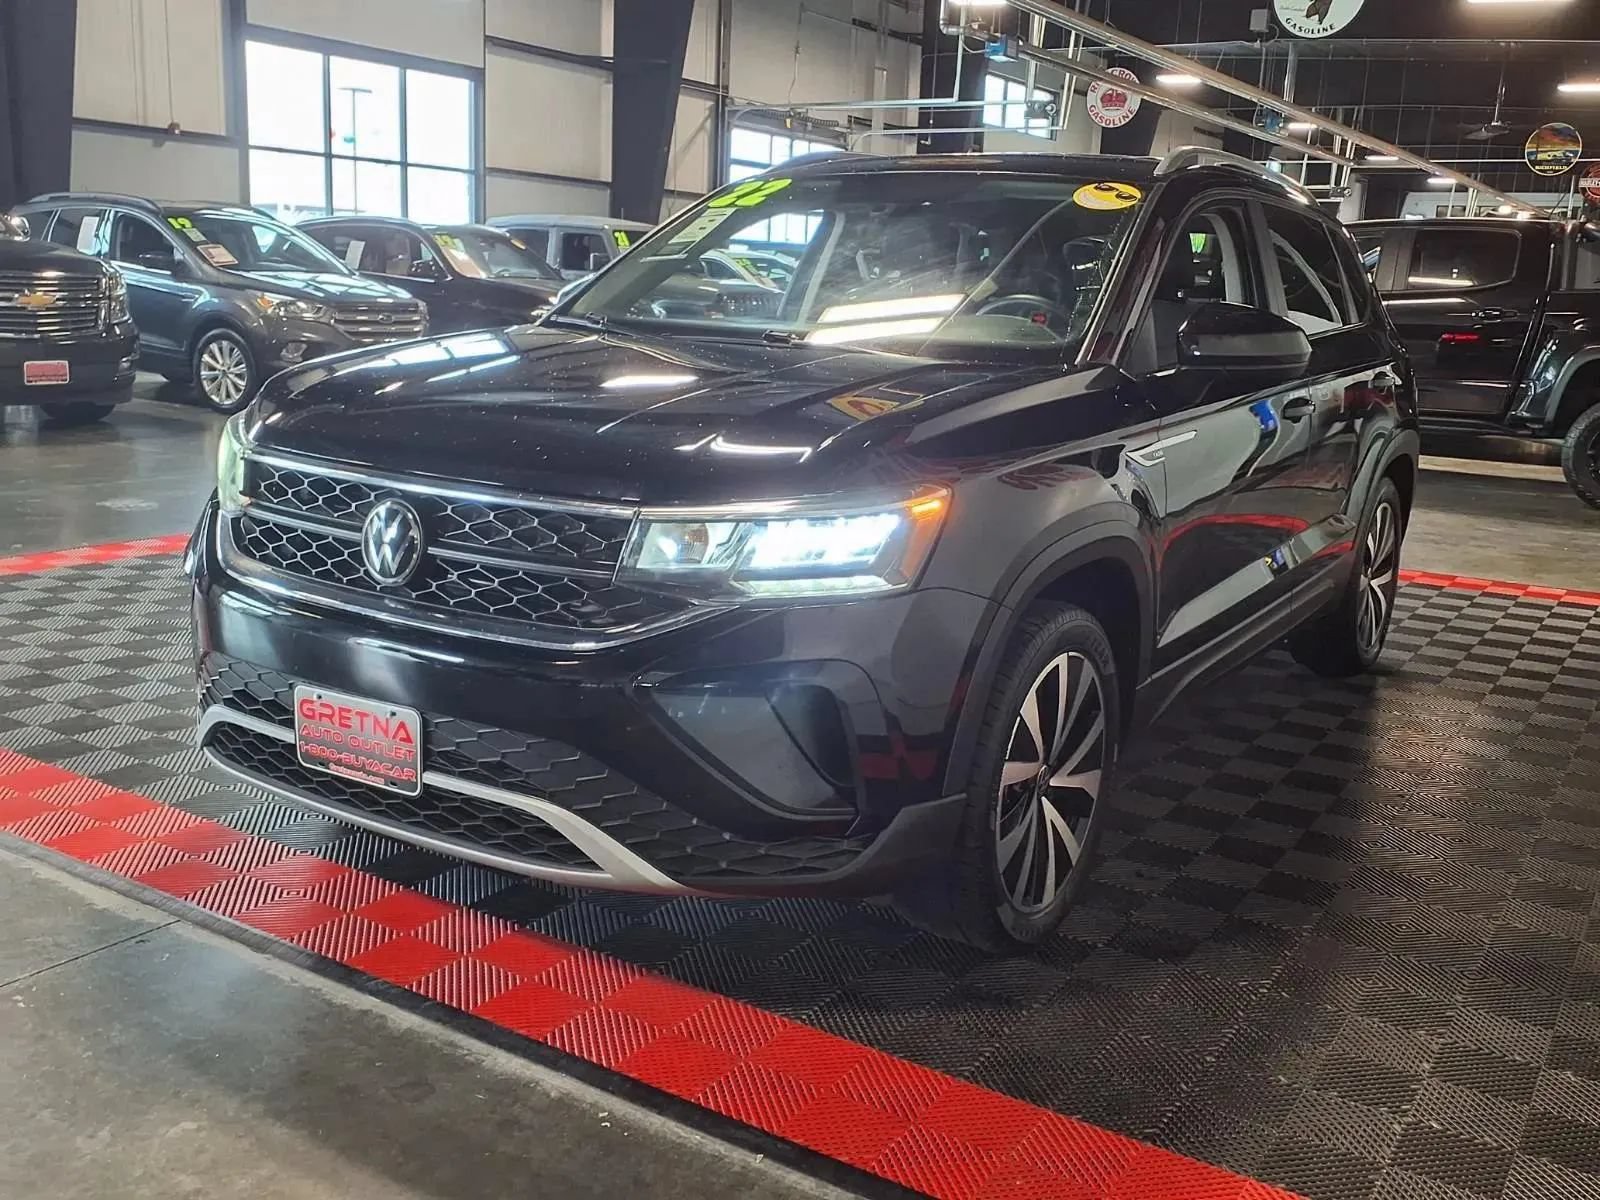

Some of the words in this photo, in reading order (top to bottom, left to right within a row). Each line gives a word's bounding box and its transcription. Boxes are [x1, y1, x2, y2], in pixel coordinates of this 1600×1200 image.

[1285, 17, 1336, 35] GASOLINE
[1089, 104, 1136, 126] GASOLINE
[707, 178, 793, 207] 22
[167, 217, 192, 229] 19
[299, 698, 414, 745] GRETNA
[300, 723, 344, 745] AUTO
[347, 734, 416, 762] OUTLET
[300, 741, 417, 781] 1-800-BUYACAR
